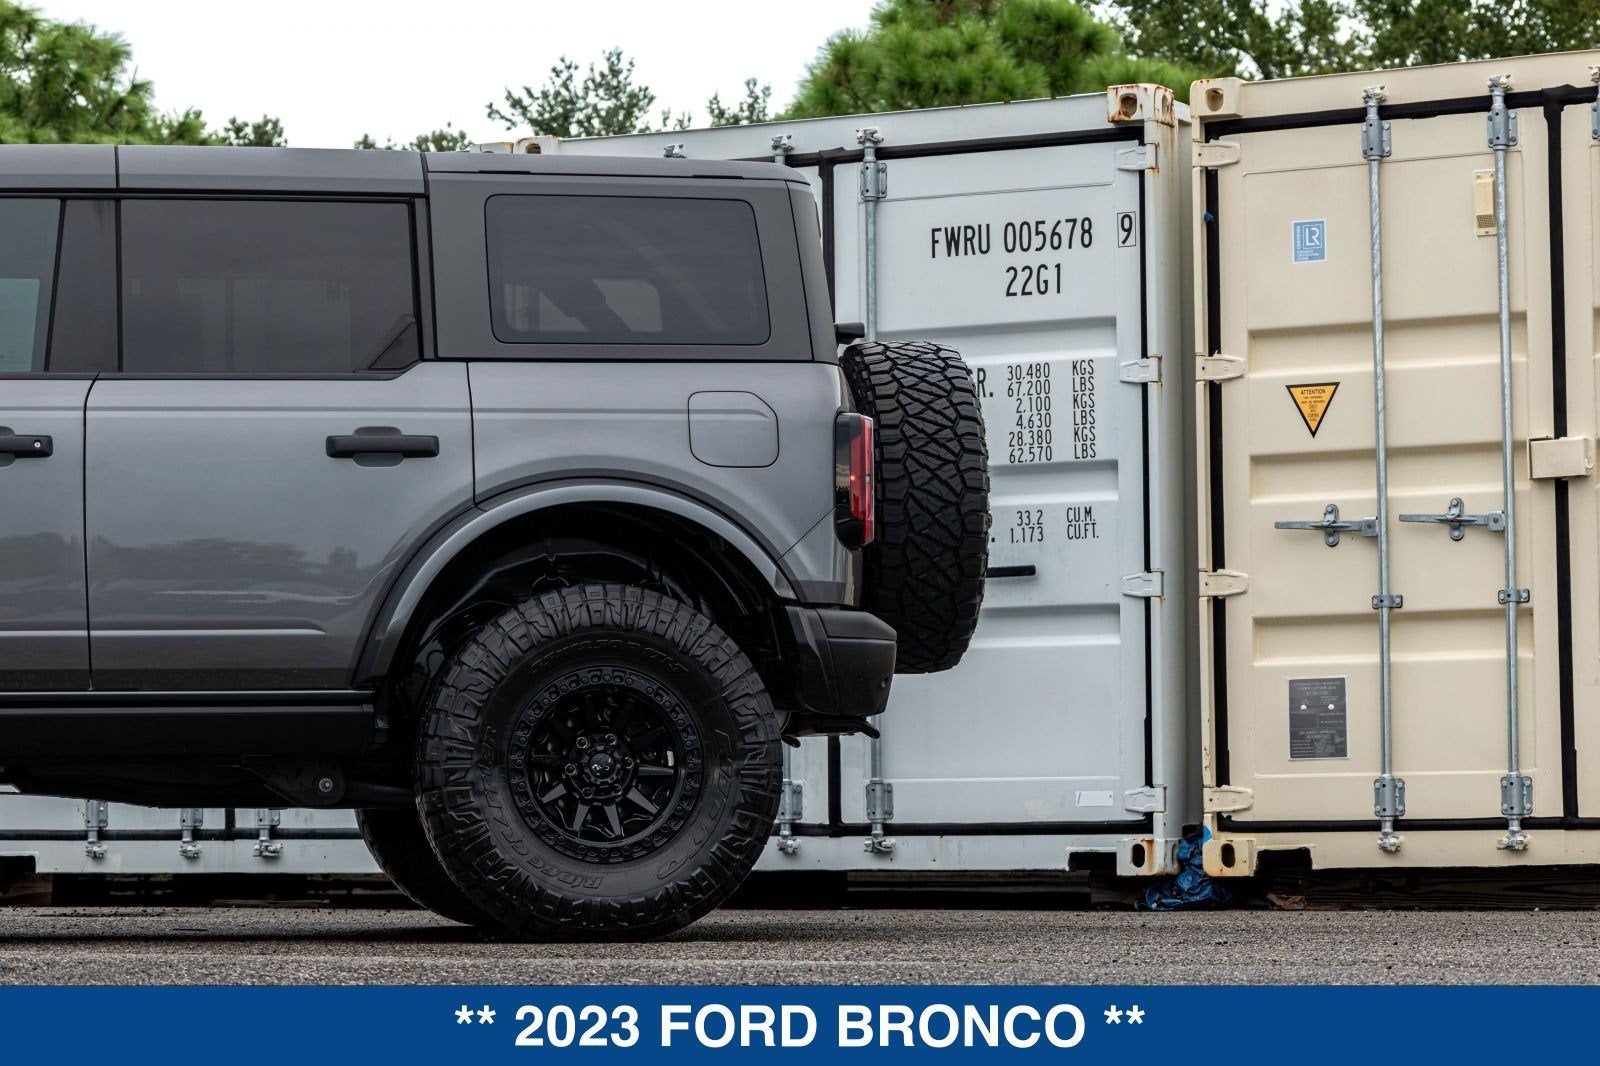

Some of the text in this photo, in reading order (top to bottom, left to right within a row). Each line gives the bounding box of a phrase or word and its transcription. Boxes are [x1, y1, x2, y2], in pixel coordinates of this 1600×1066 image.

[931, 213, 1134, 259] FWRU 005678 9
[1005, 262, 1061, 297] 22G1
[1007, 359, 1095, 381] 30,480 KGS
[1007, 376, 1095, 398] 67,200 LBS
[1016, 393, 1095, 414] 2,100 KGS
[1016, 409, 1096, 430] 4,630 LBS
[1008, 426, 1096, 447] 28,380 KGS
[1009, 443, 1097, 464] 62,570 LBS
[1016, 506, 1096, 527] 33.2 CU.M.
[1010, 522, 1100, 544] 1,173 CU.FT.
[526, 857, 603, 889] RIDGE
